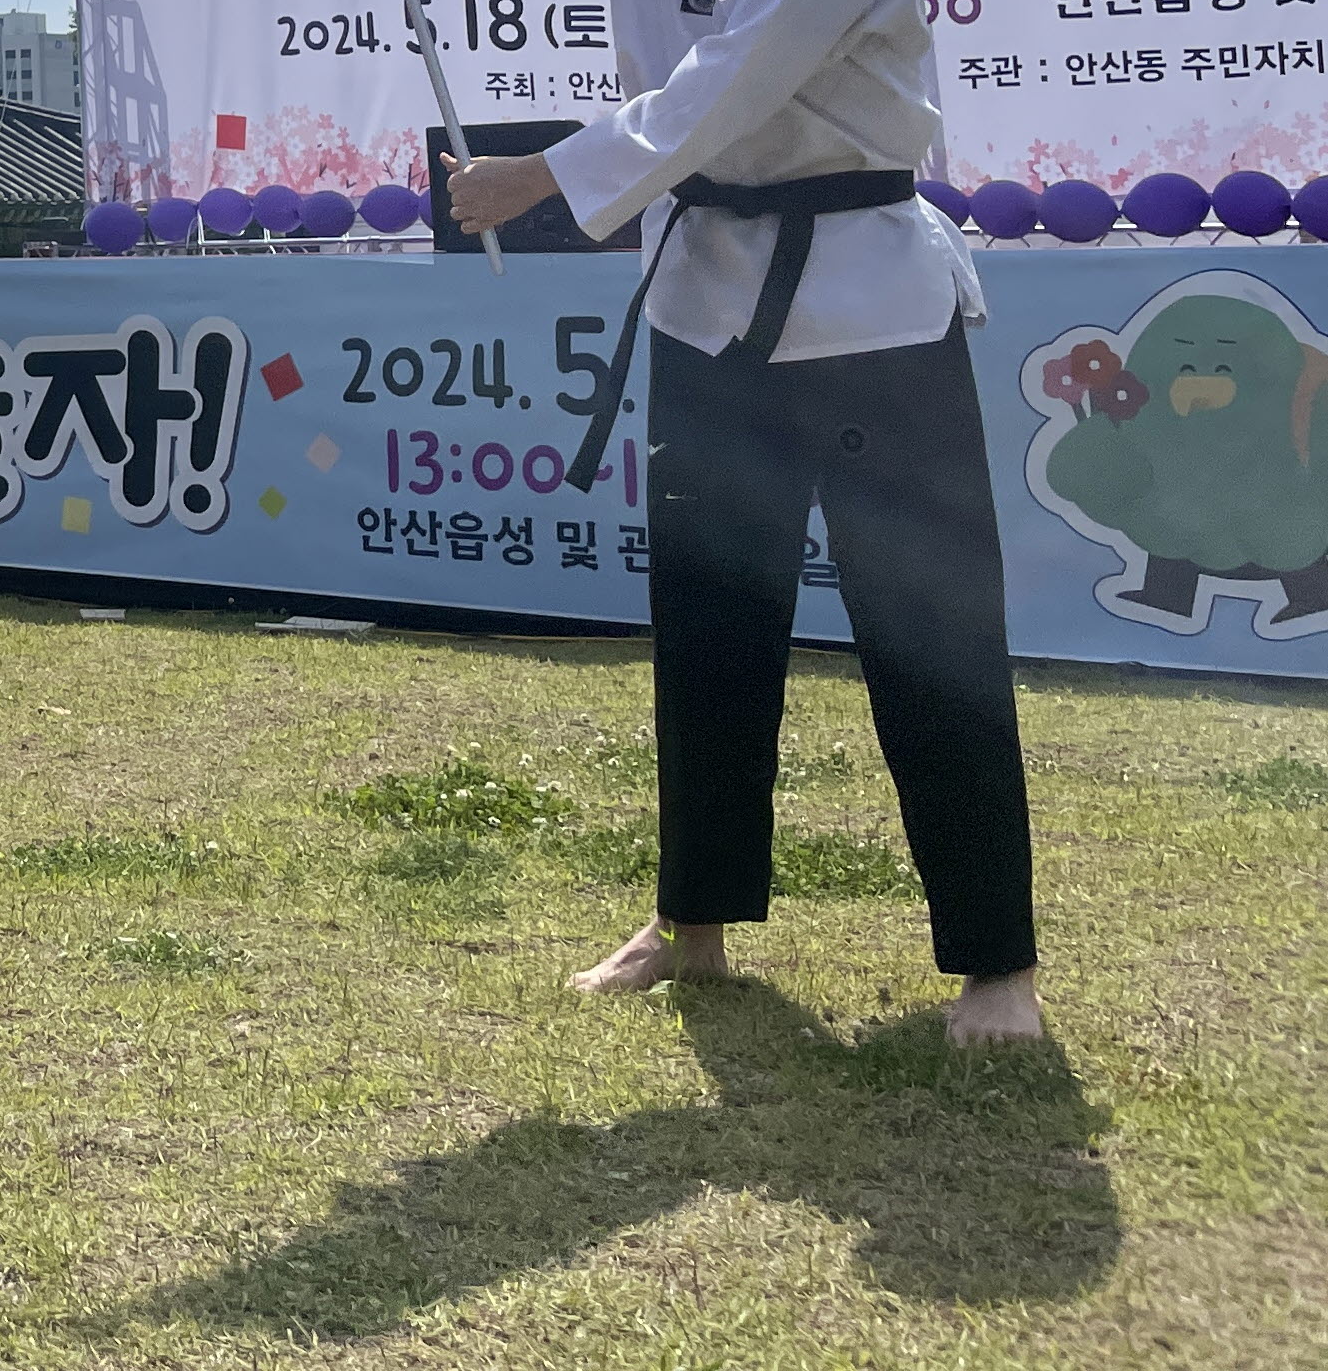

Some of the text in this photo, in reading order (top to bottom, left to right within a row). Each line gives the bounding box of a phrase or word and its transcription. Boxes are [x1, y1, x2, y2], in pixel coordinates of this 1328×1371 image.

[485, 71, 536, 102] 주최
[958, 54, 1023, 89] 주관
[1065, 48, 1168, 86] 안산동
[1181, 39, 1326, 82] 주민자치
[357, 507, 535, 566] 안산읍성
[556, 521, 599, 571] 및
